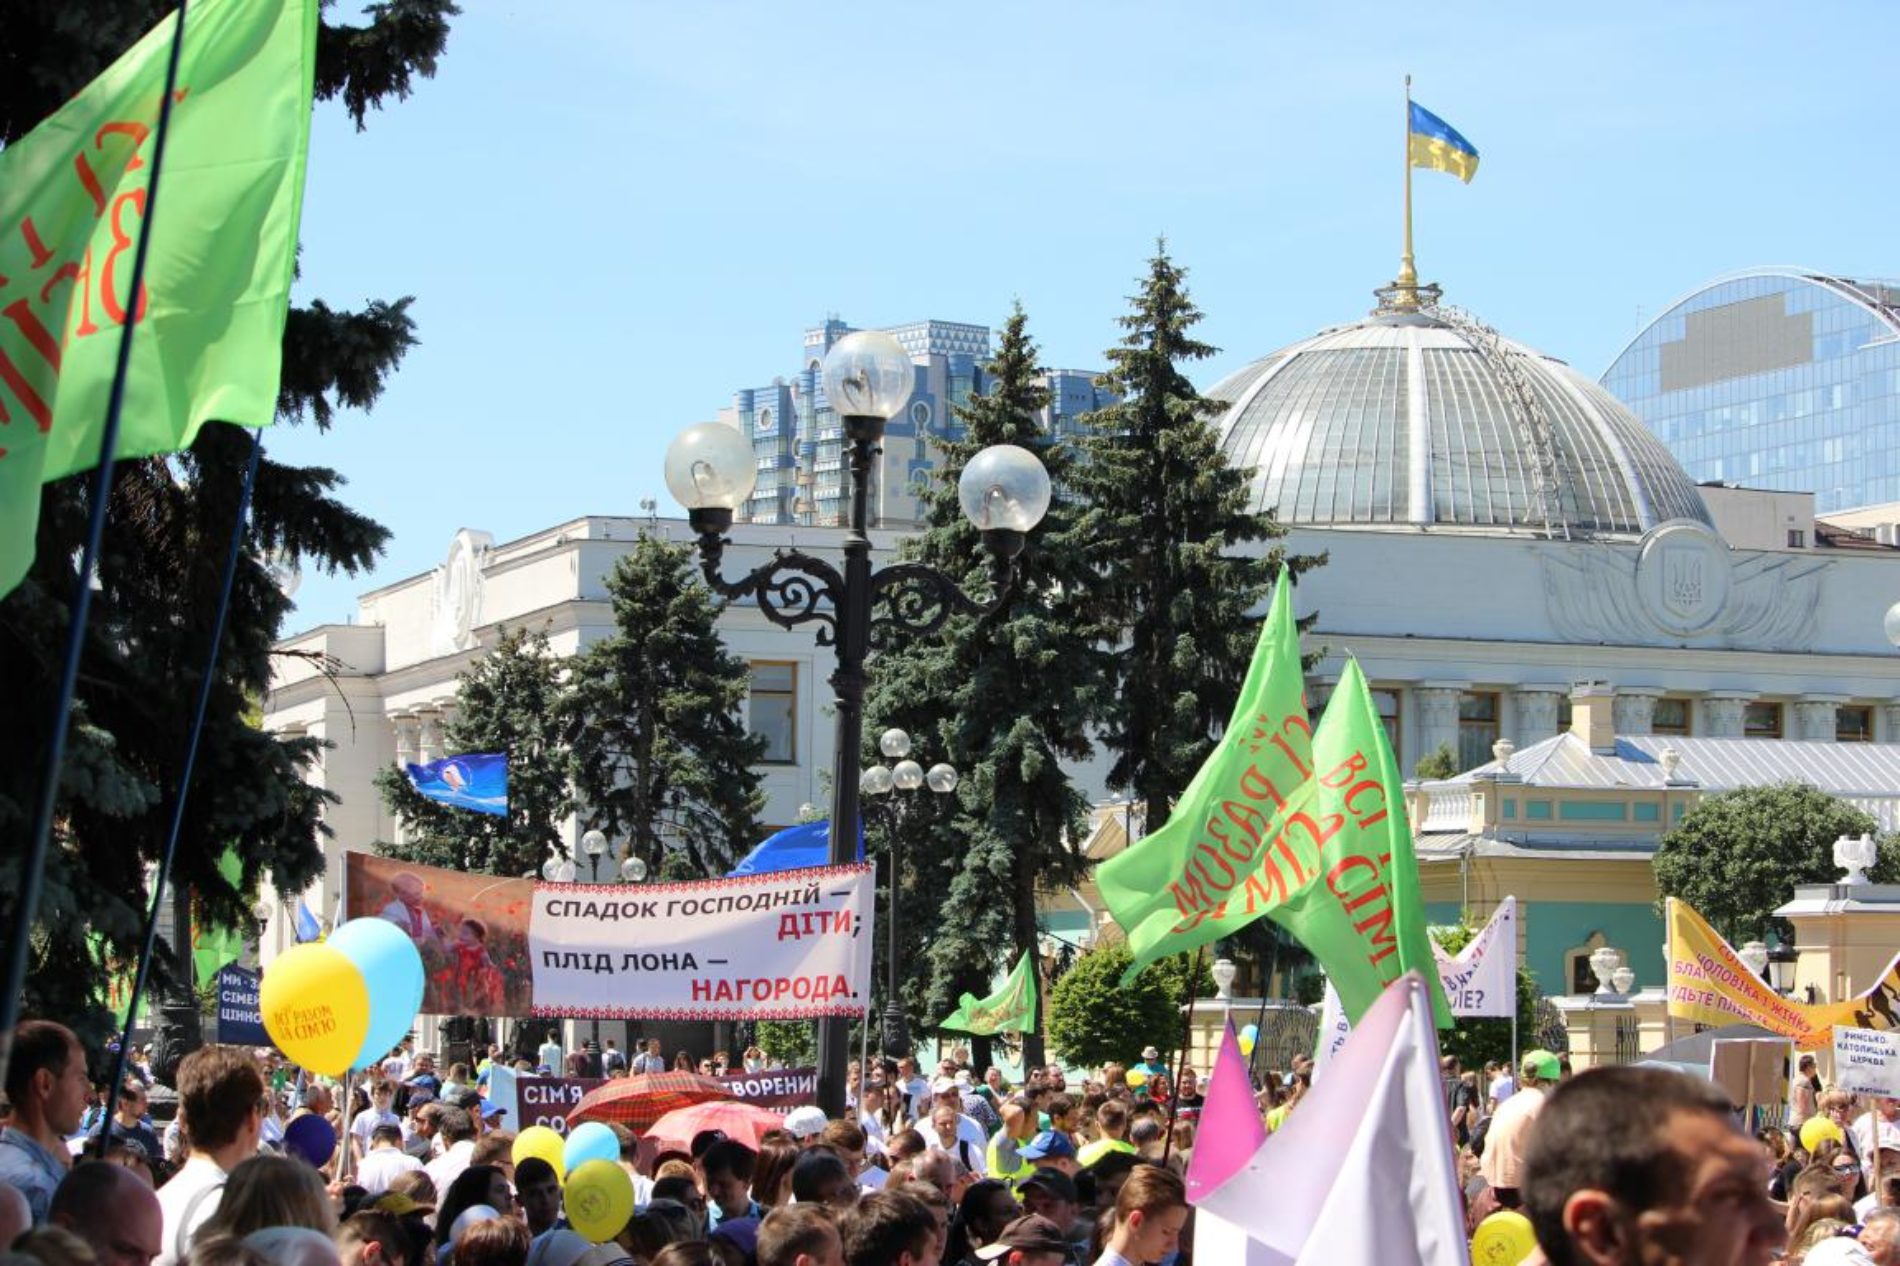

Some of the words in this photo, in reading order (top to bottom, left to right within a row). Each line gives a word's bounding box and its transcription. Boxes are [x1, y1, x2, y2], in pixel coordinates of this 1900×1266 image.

[545, 899, 658, 921] СПАДОК
[666, 882, 820, 917] ГОСПОДНІЙ
[778, 910, 861, 941] ДІТИ;
[543, 951, 614, 975] ПЛІД
[621, 953, 698, 972] ЛОНА
[1696, 953, 1760, 1000] ЧОЛОВІКА
[691, 975, 858, 1003] НАГОРОДА.
[221, 1008, 262, 1024] ЦІННО
[524, 1083, 583, 1104] СІМ'Я
